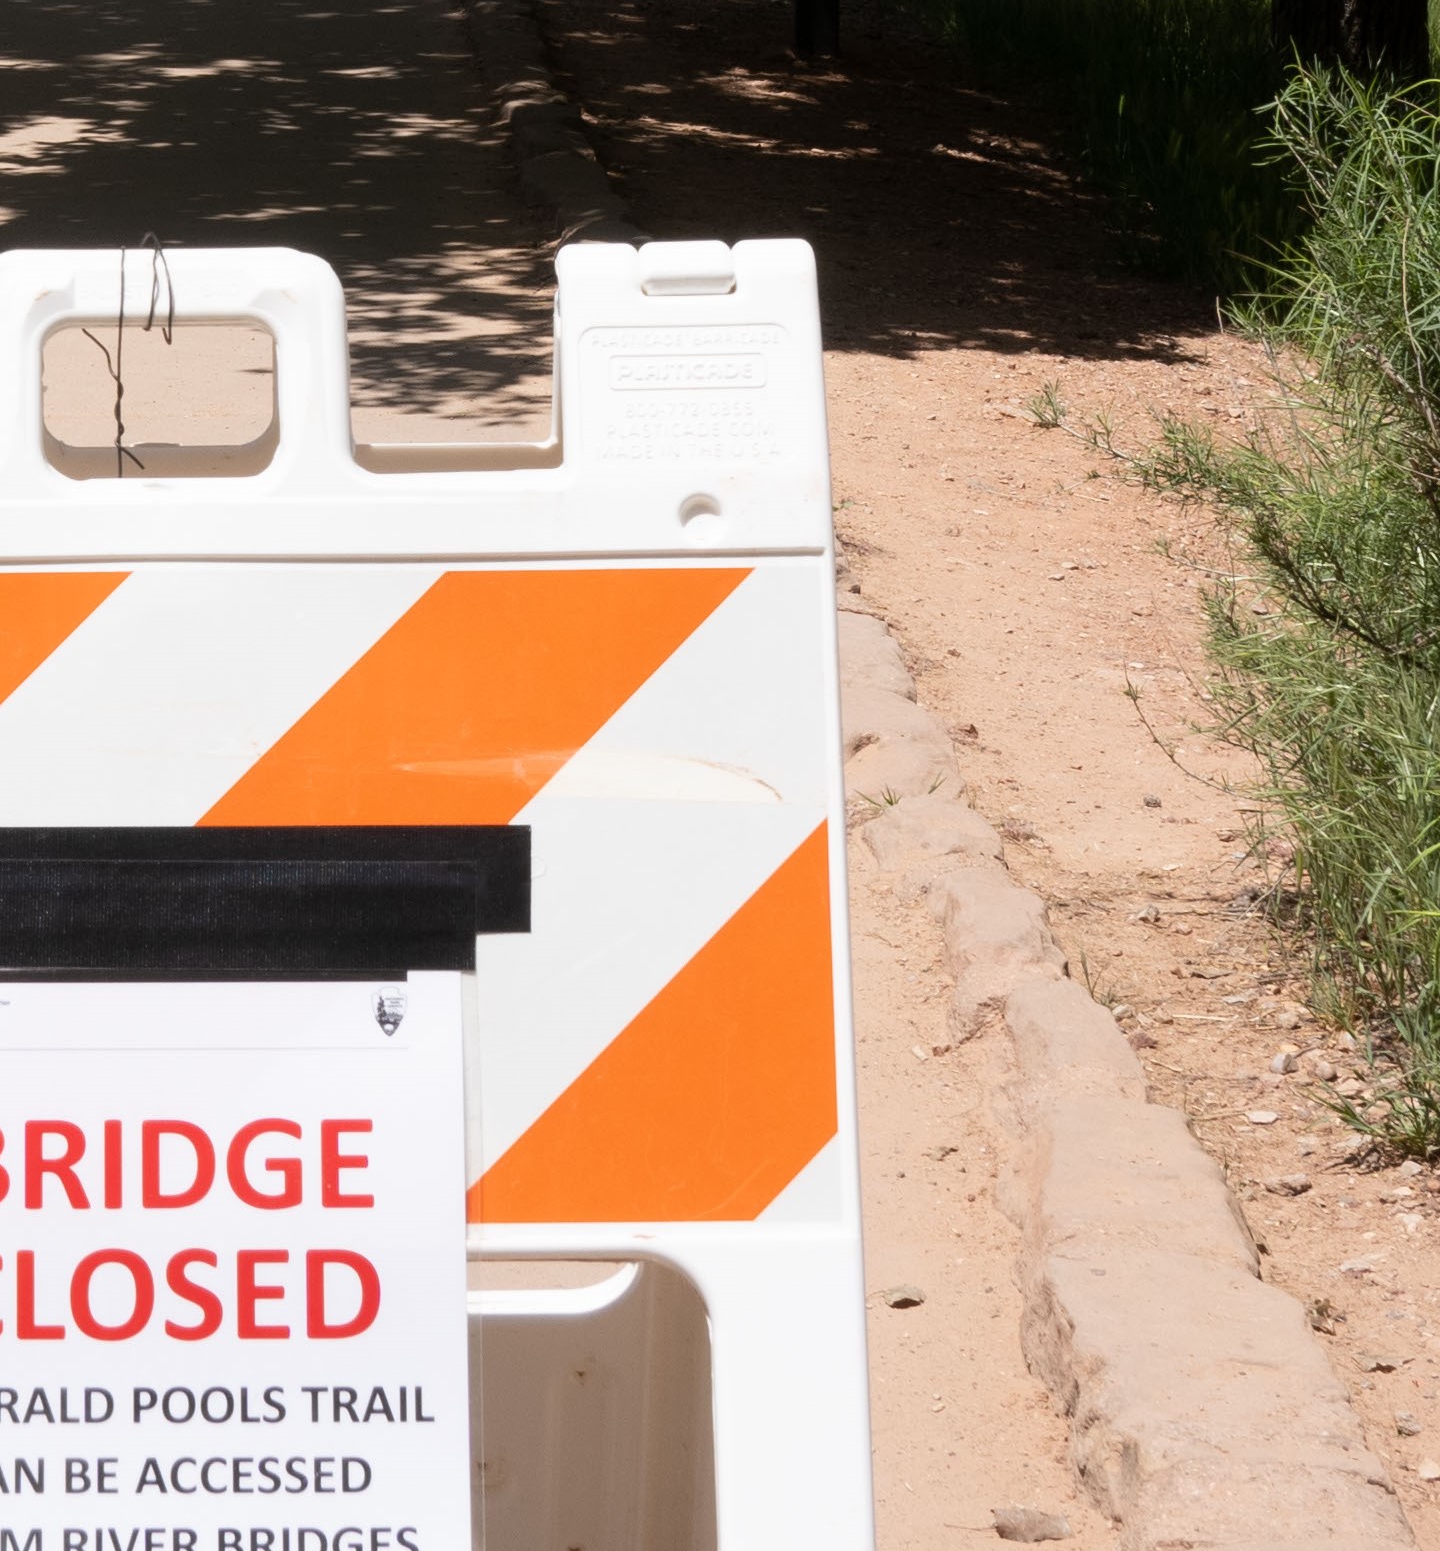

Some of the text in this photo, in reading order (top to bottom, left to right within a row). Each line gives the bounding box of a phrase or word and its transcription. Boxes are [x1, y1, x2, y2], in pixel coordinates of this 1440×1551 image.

[617, 363, 753, 382] PLASTICADE
[133, 1386, 287, 1424] POOLS
[301, 1386, 435, 1423] TRAIL
[65, 1458, 118, 1494] BE
[135, 1456, 372, 1494] ACCESSED
